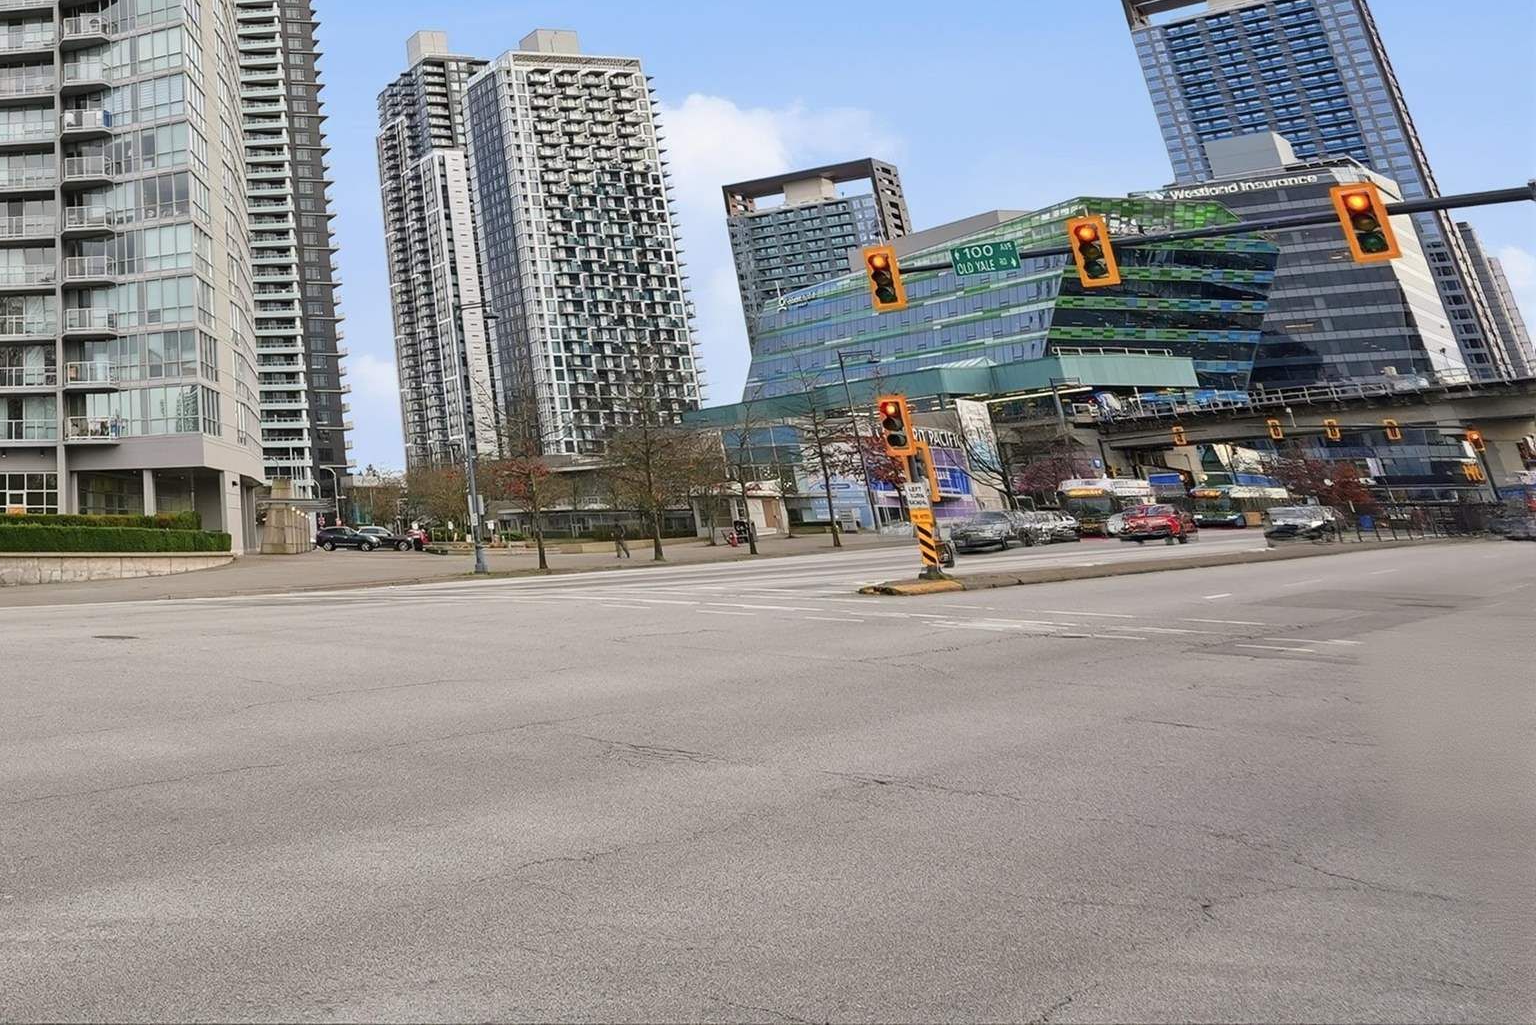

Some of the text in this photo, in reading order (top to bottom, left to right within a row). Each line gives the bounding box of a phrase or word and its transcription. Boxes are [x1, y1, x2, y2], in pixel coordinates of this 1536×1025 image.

[1169, 174, 1318, 200] Westland Insurance
[963, 242, 1013, 259] 100 AVE
[957, 261, 974, 275] OLD
[975, 259, 996, 272] YALE
